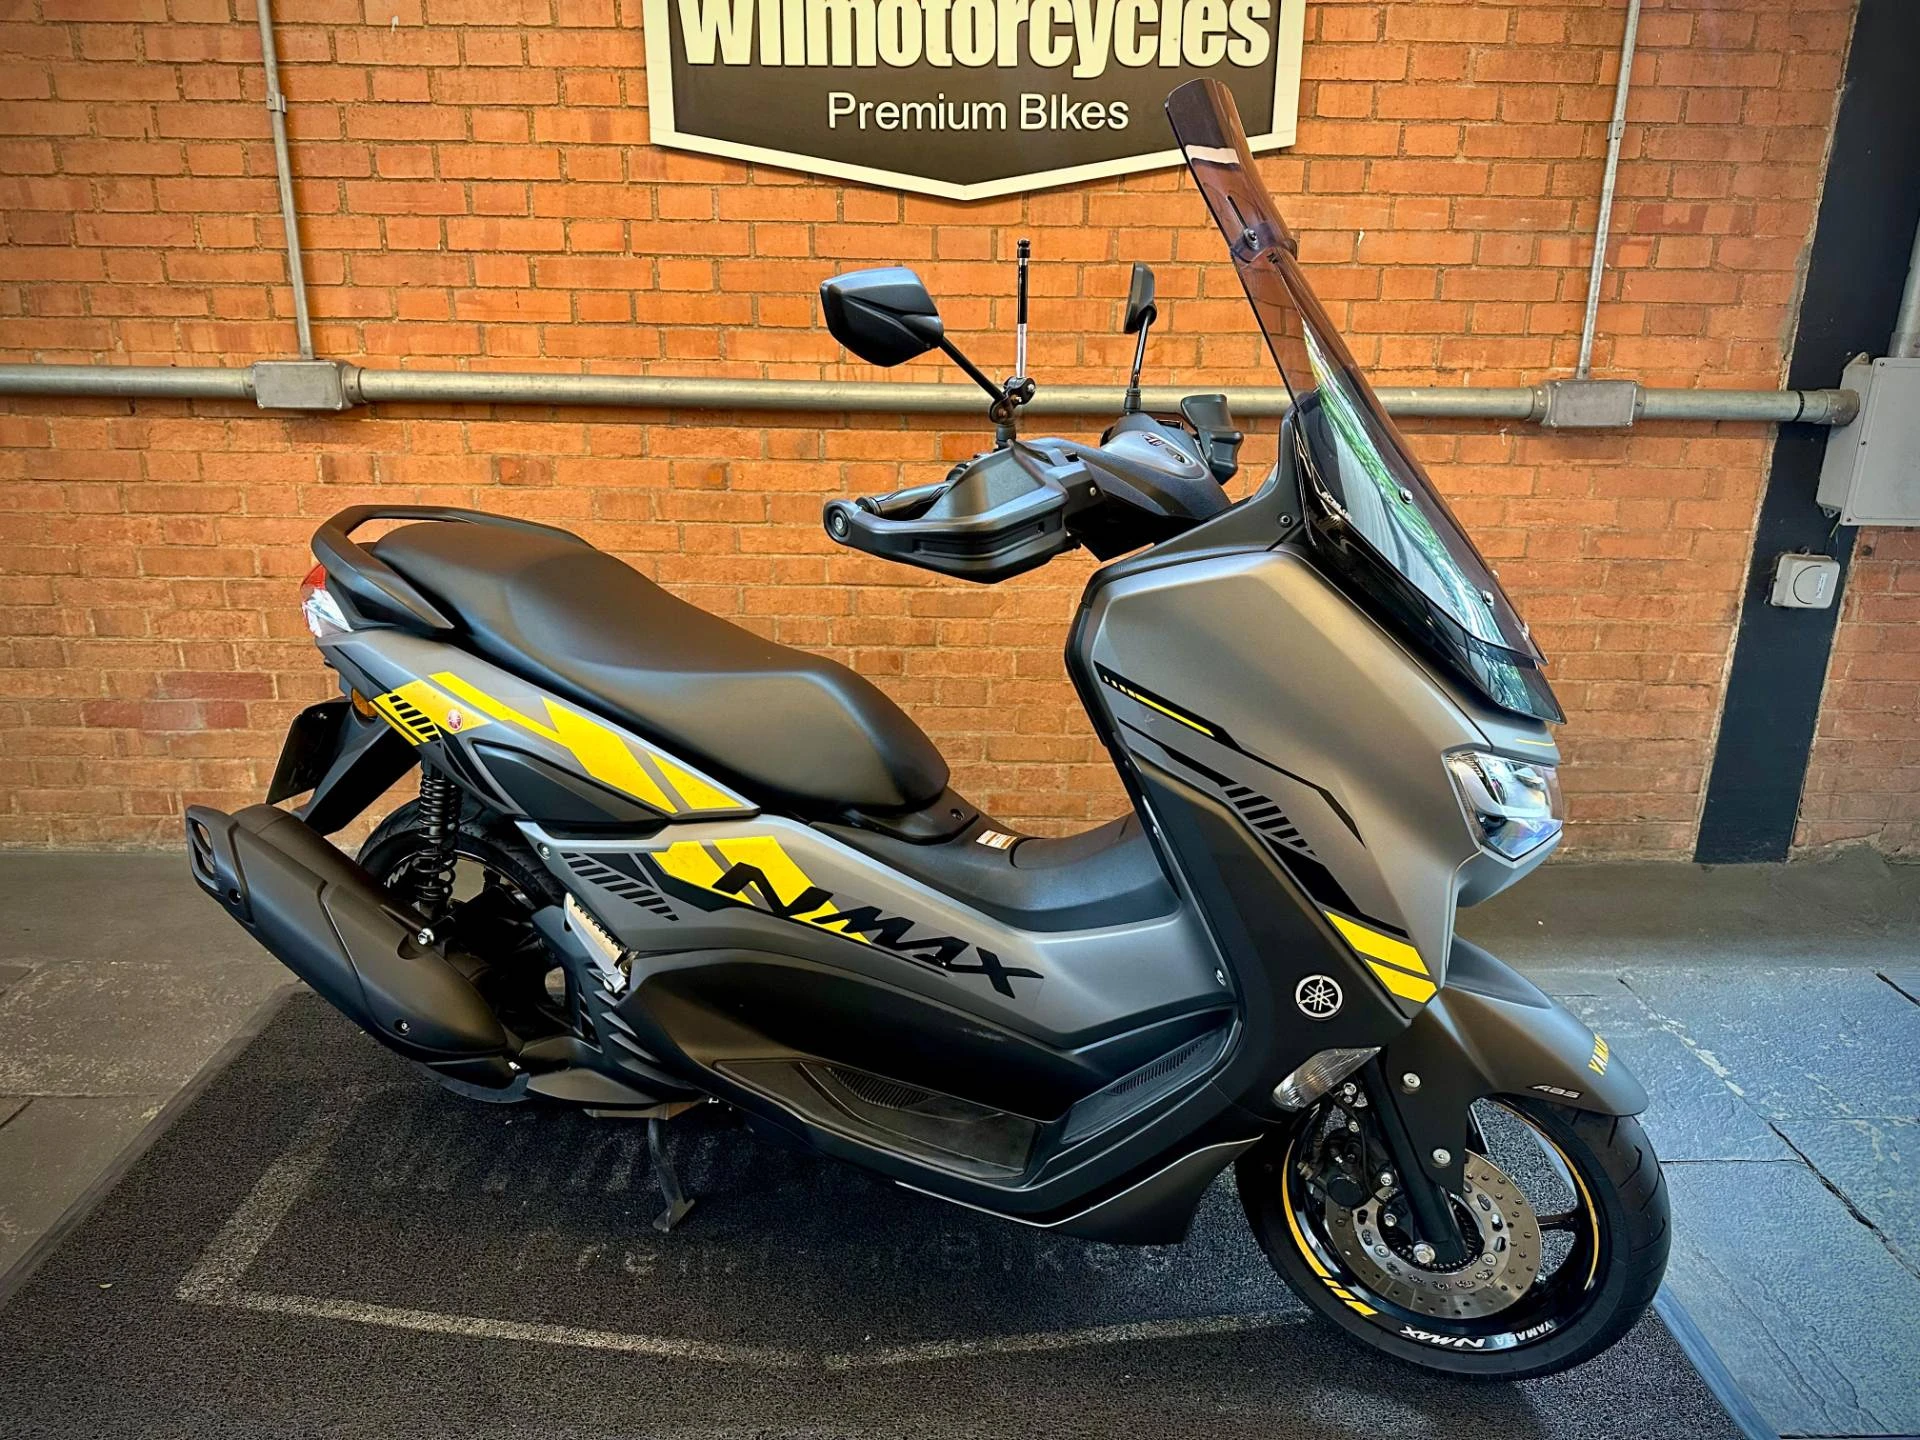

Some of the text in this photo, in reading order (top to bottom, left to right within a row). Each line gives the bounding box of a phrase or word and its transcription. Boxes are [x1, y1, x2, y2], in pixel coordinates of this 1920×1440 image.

[828, 91, 1007, 131] Premium
[712, 861, 1044, 999] NMAX
[1531, 1084, 1581, 1099] ABS
[1399, 1325, 1486, 1348] NMAX
